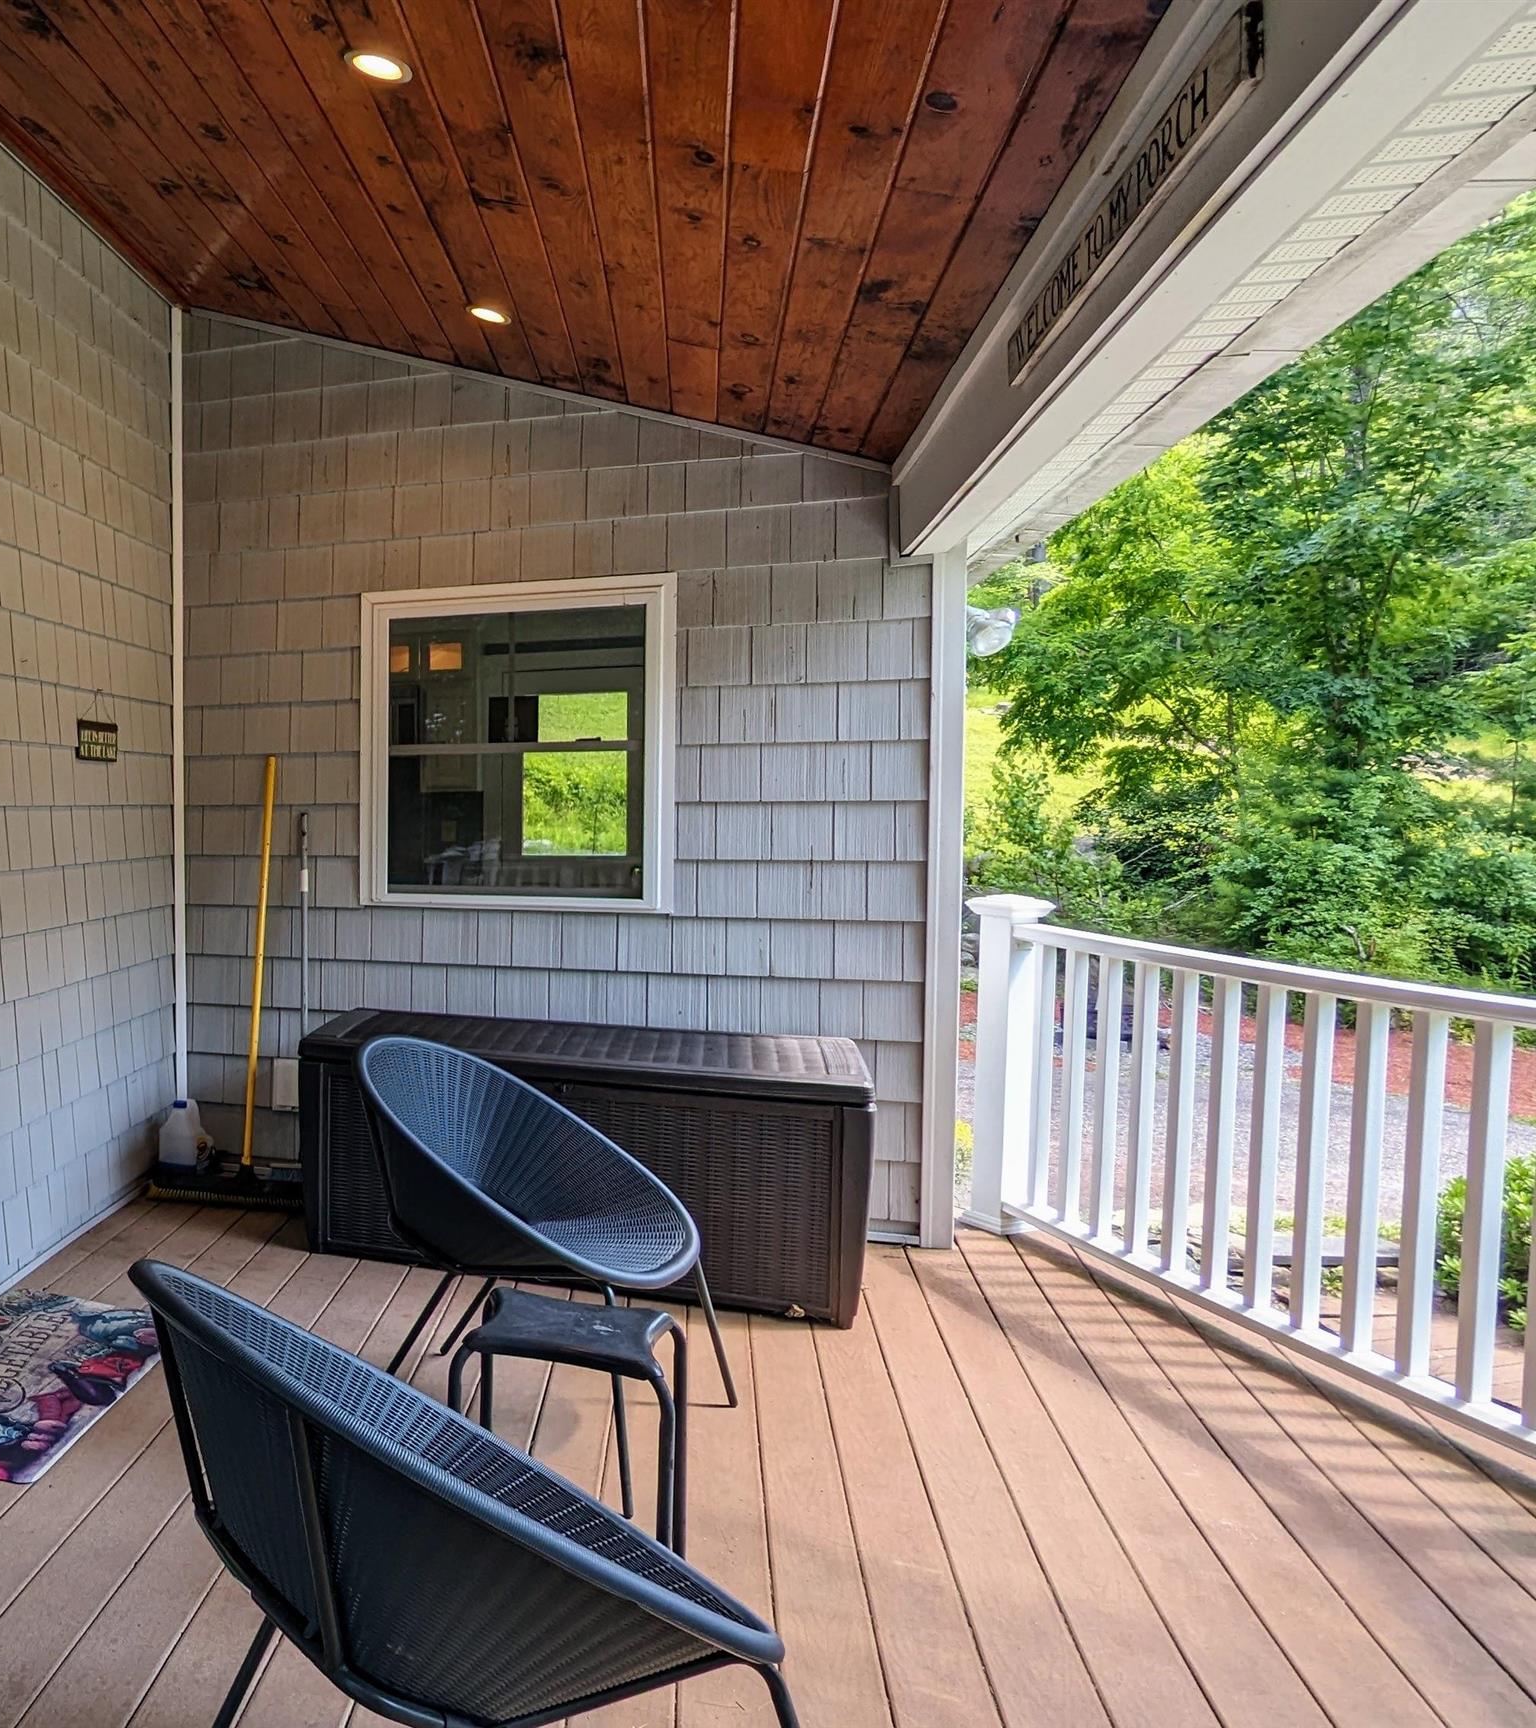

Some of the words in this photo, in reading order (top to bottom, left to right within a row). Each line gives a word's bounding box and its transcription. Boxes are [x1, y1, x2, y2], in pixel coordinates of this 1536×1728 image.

[1015, 243, 1082, 361] WELCOME
[1084, 215, 1105, 270] TO
[1108, 174, 1133, 244] MY
[1135, 66, 1210, 207] PORCH
